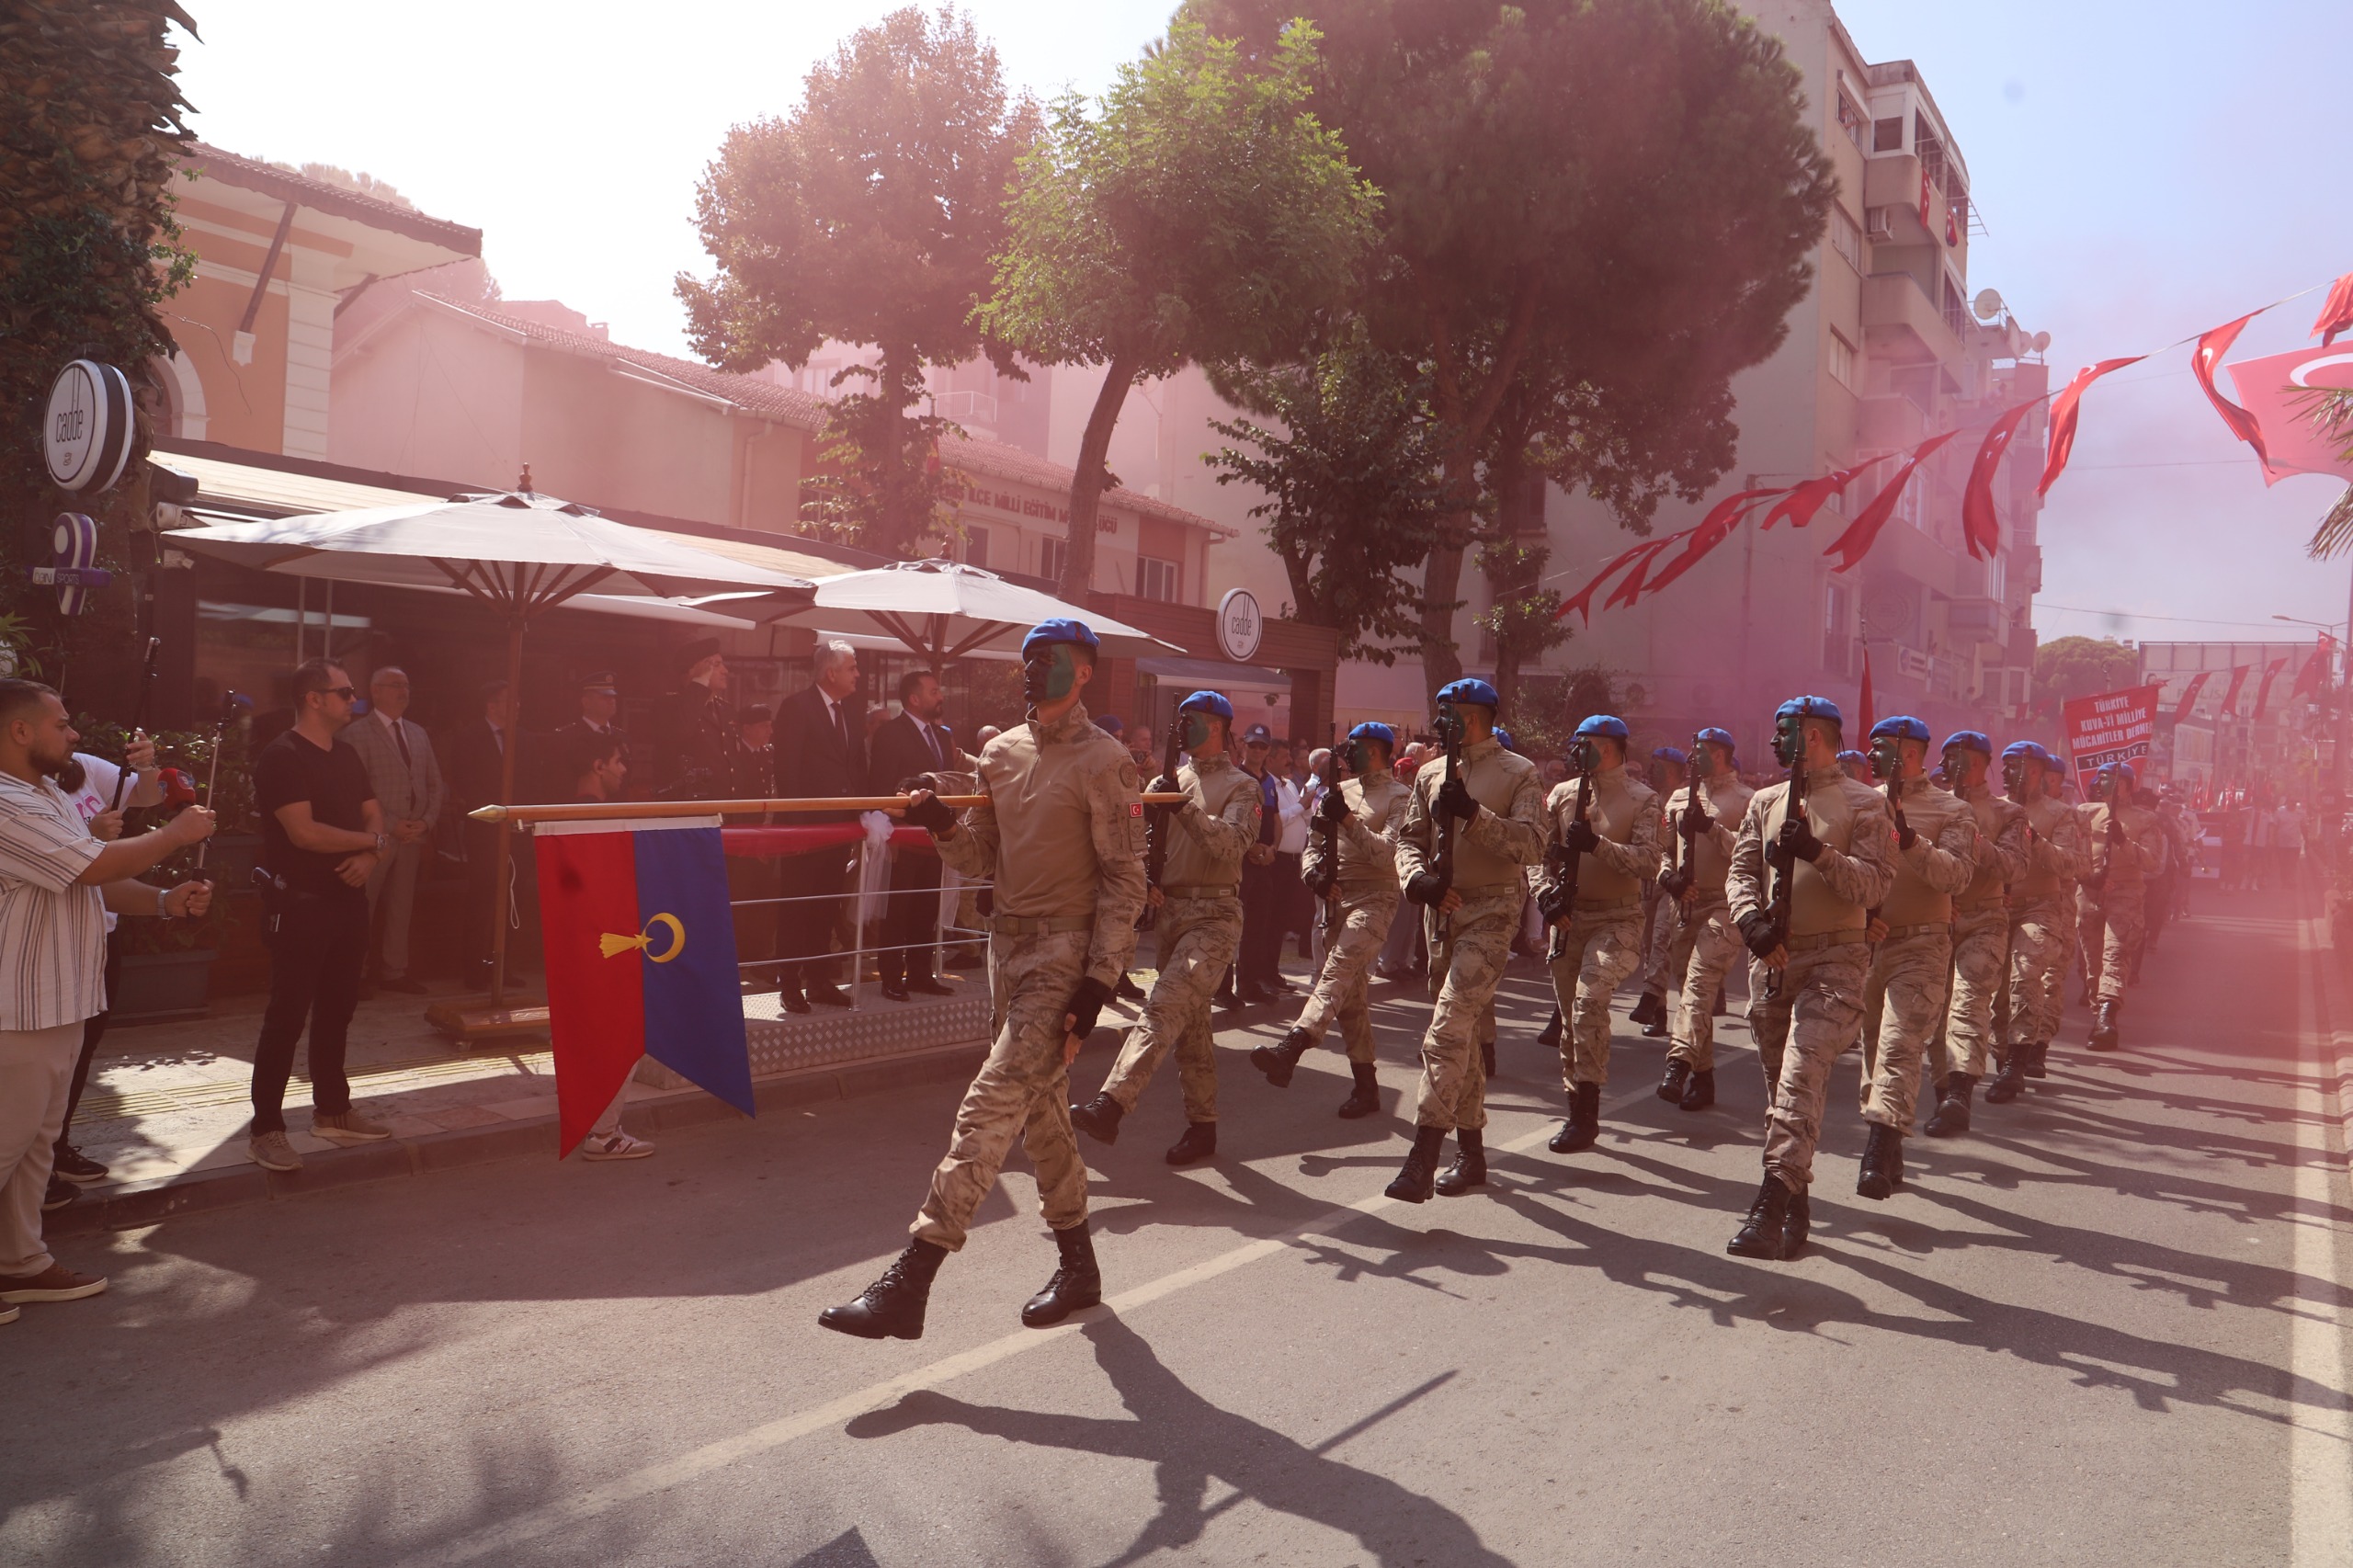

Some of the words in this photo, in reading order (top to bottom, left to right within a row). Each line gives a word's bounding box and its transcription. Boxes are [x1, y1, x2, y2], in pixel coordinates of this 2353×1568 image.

[995, 491, 1021, 513] MİLLİ
[1024, 499, 1056, 521] EĞİTİM
[56, 573, 80, 585] SPORTS
[2094, 696, 2130, 713] TÜRKİYE
[2116, 707, 2147, 726] MİLLİYE
[2072, 729, 2124, 750] MÜCAHİTLER
[2086, 745, 2147, 767] TÜRKİYE
